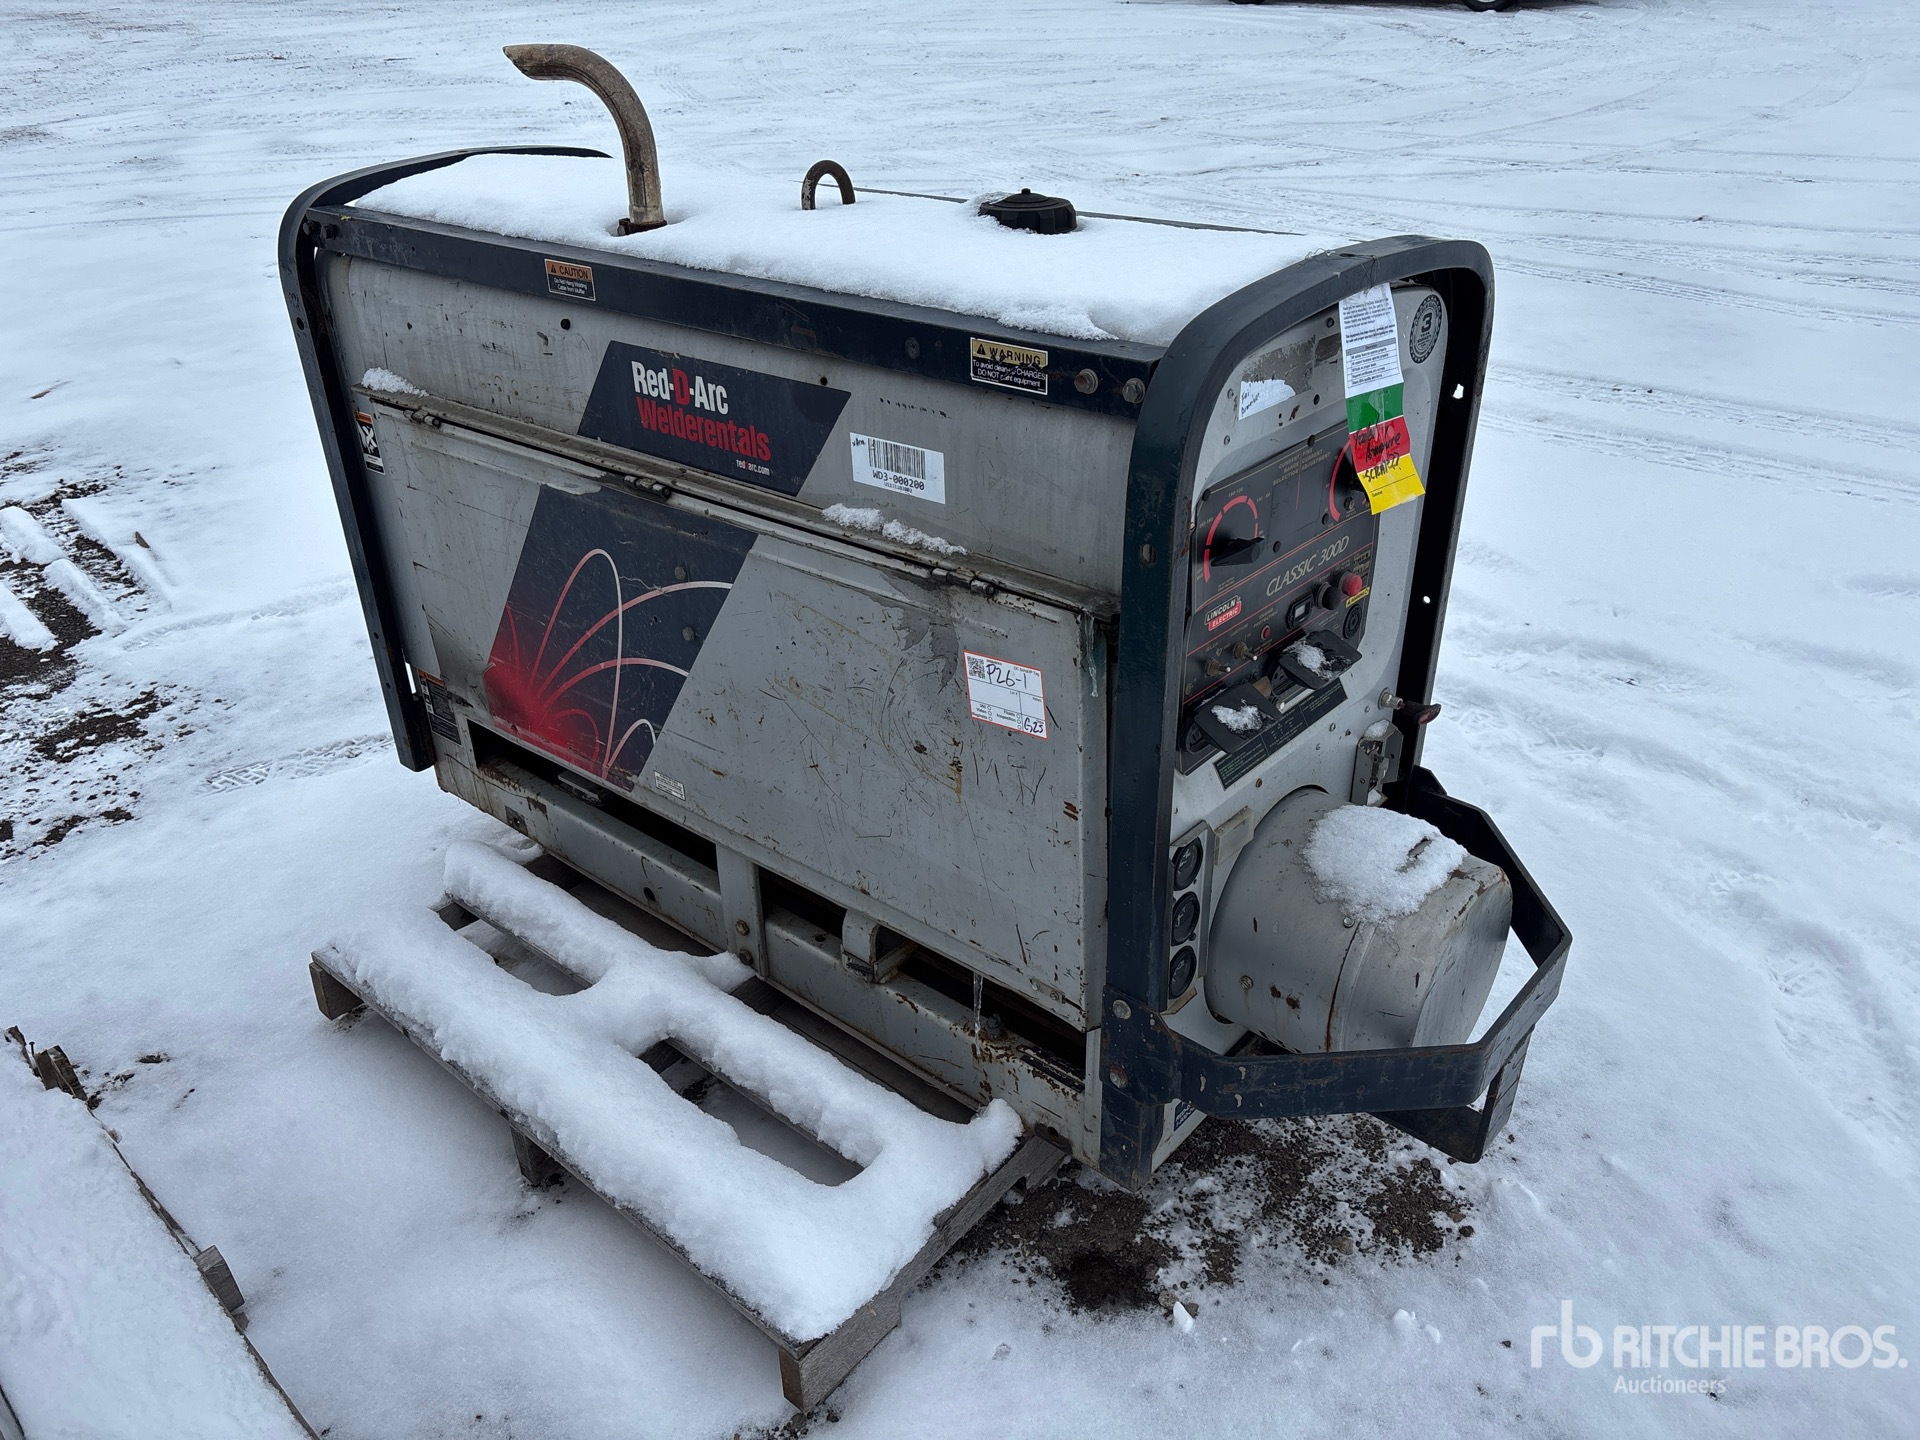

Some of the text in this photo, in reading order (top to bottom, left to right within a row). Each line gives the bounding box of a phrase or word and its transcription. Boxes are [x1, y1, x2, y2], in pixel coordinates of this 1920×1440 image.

[560, 265, 589, 280] CAUTION
[1421, 312, 1433, 333] 3
[989, 346, 1041, 366] WARNING
[973, 359, 980, 367] To
[980, 360, 993, 370] avoid
[1016, 368, 1046, 381] CHARGES
[977, 368, 987, 376] DO
[987, 370, 1000, 379] NOT
[1013, 376, 1041, 388] equipment
[631, 360, 729, 415] Red-D-Arc
[635, 396, 772, 462] Welderentals
[872, 469, 925, 491] WD3-000200
[1266, 554, 1317, 597] CLASSIC
[1317, 535, 1350, 567] 300D
[1206, 599, 1237, 622] LINCOLN
[1212, 606, 1239, 628] ELECTRIC
[986, 663, 1027, 690] P26-1
